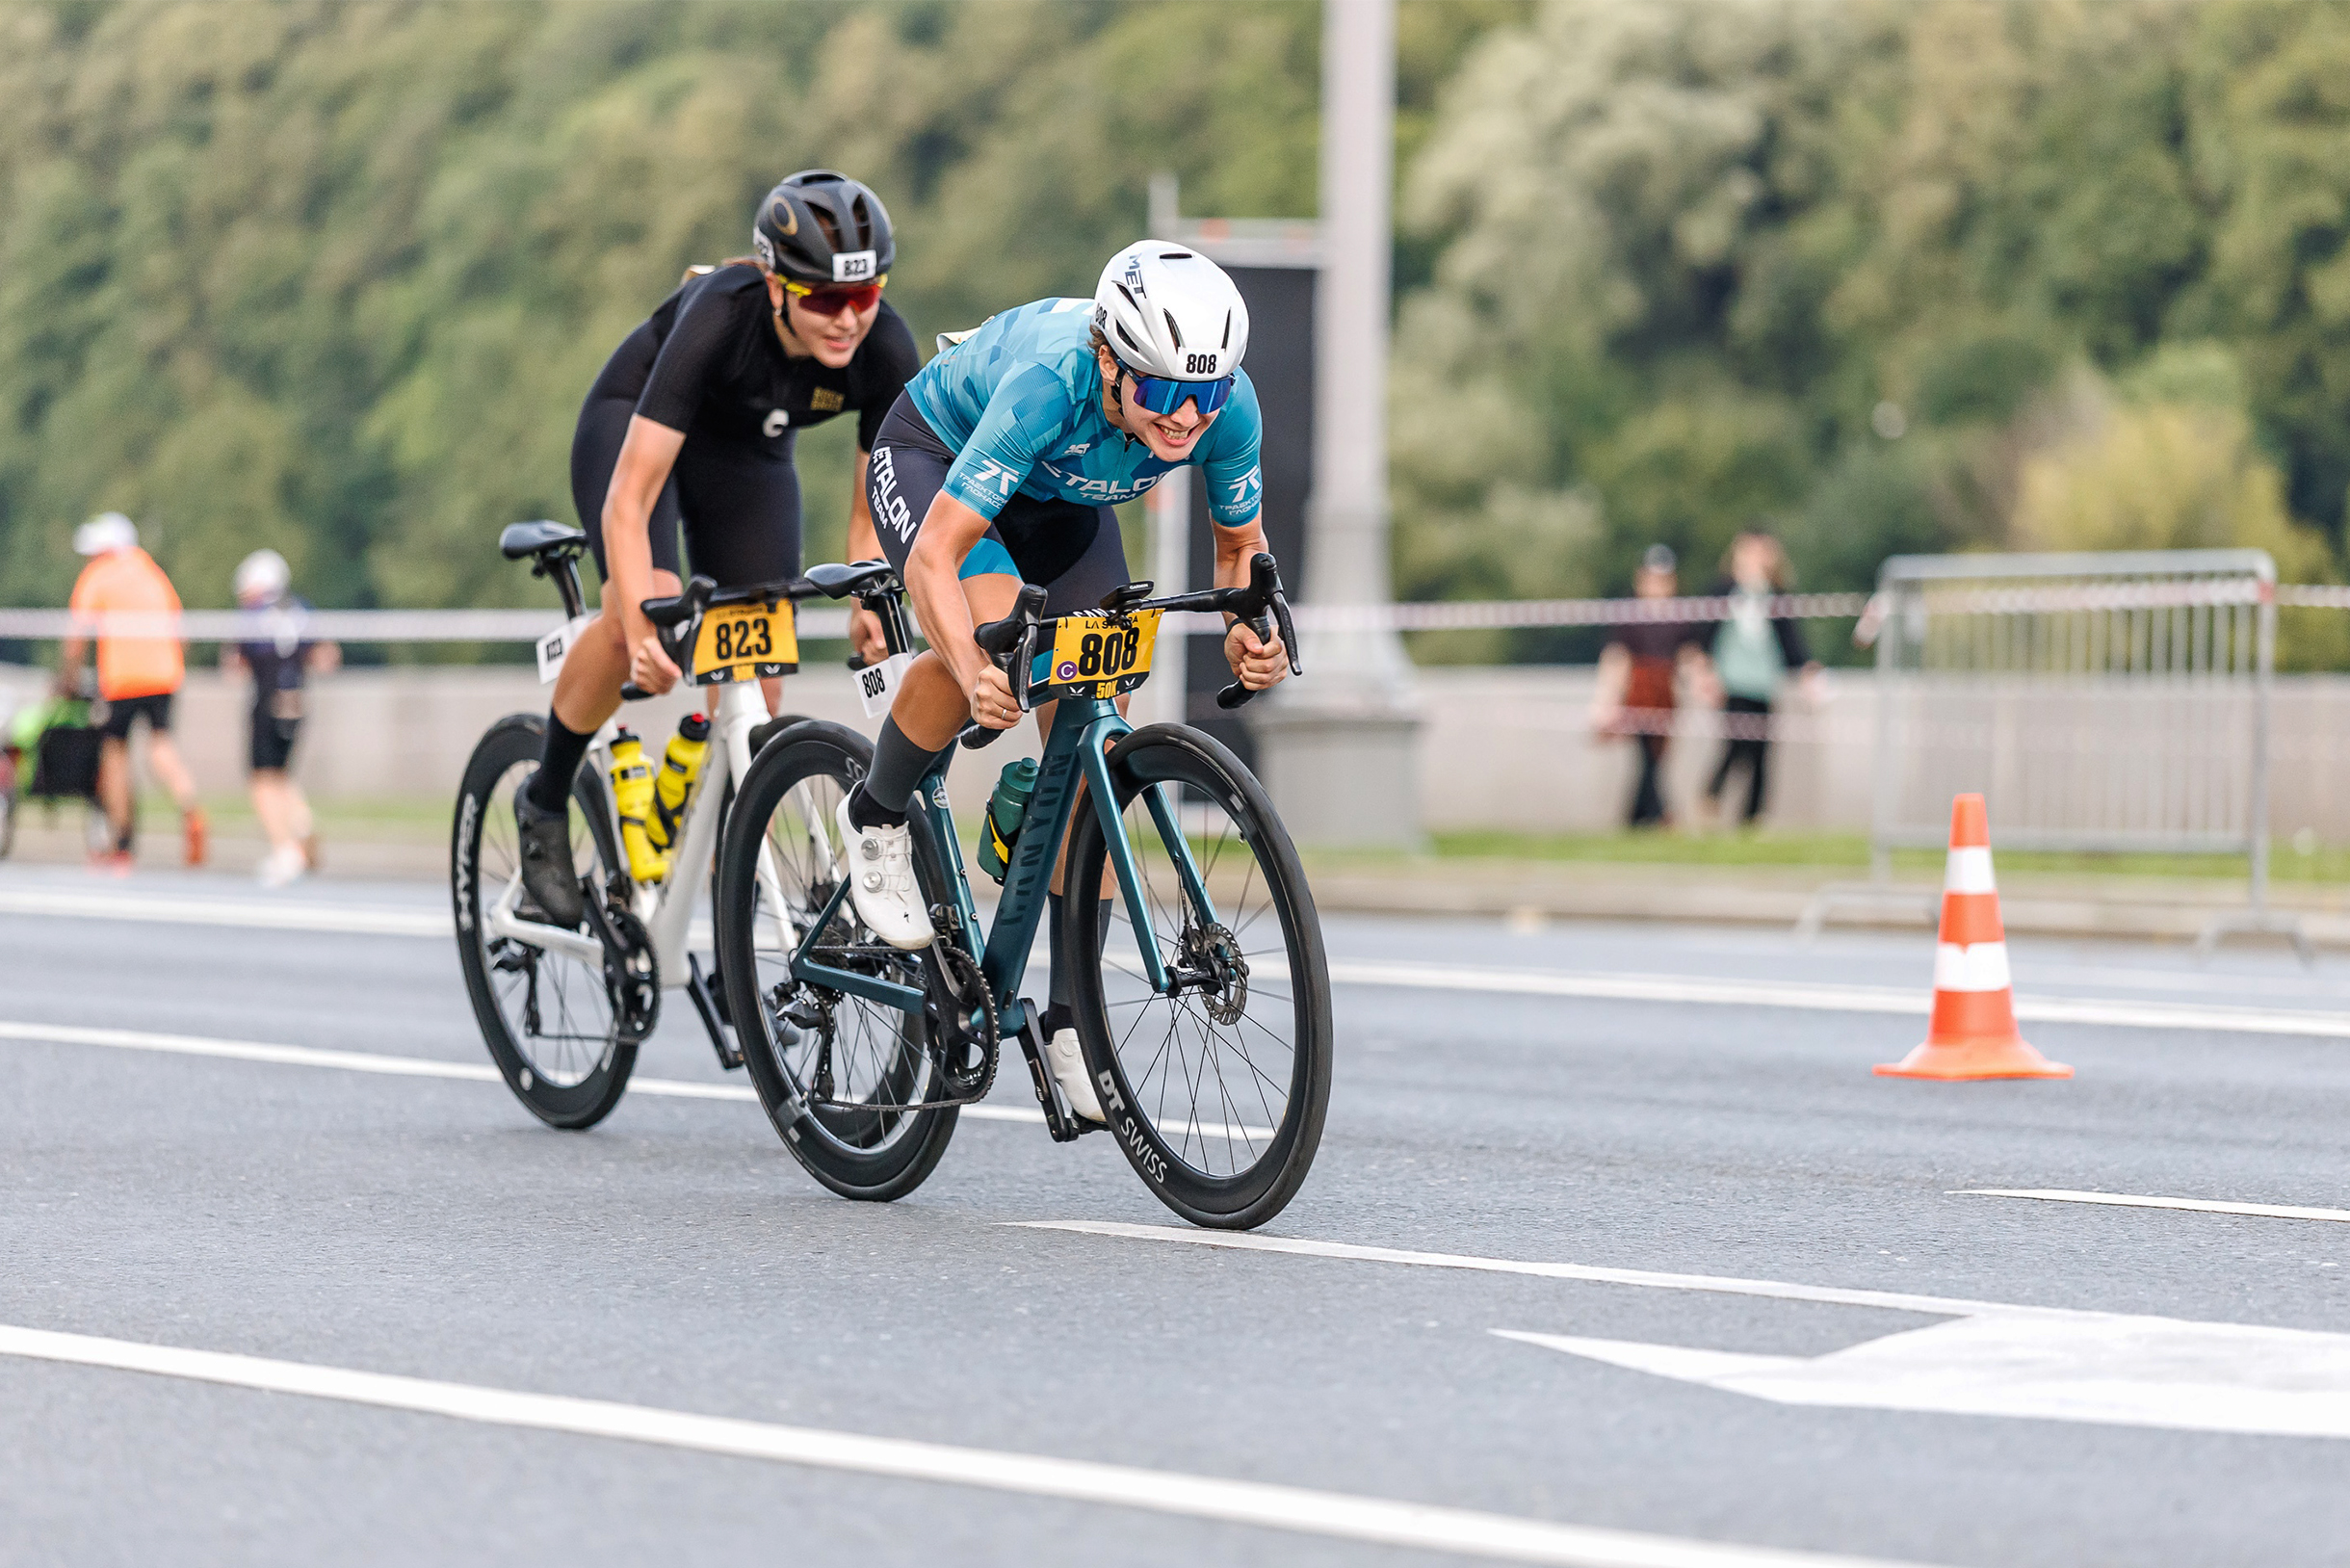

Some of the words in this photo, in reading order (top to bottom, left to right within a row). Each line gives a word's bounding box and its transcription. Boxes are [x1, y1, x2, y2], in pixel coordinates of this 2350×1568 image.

[1125, 252, 1147, 299] MET
[1185, 353, 1217, 375] 808
[872, 446, 917, 544] ETALON
[872, 484, 888, 530] TEAM
[1079, 491, 1136, 502] TEAM
[716, 618, 771, 661] 823
[1084, 619, 1100, 629] LA
[1078, 627, 1140, 677] 808
[861, 668, 886, 699] 808
[1060, 664, 1074, 678] C
[1096, 679, 1118, 699] 50K
[1097, 1069, 1126, 1112] DT
[1120, 1116, 1168, 1185] SWISS
